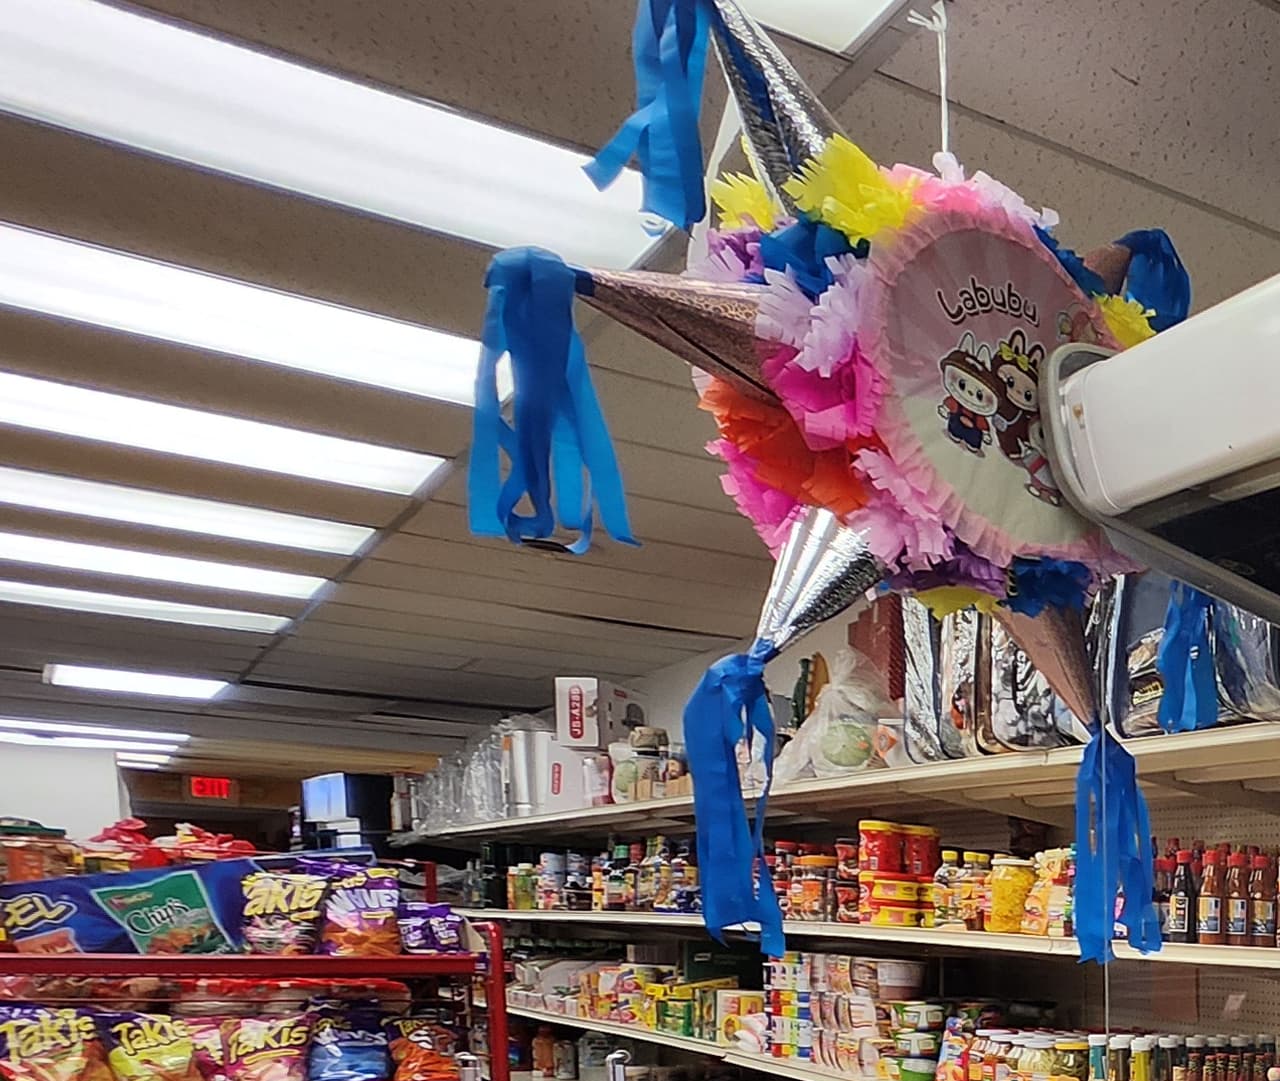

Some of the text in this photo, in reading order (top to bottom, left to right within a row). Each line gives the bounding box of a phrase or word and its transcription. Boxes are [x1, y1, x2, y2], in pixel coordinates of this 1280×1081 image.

[937, 276, 1040, 327] Labubu
[190, 776, 232, 800] EXIT
[0, 1009, 96, 1066] Takis
[110, 1014, 189, 1056] Takis
[228, 1018, 311, 1064] Takis
